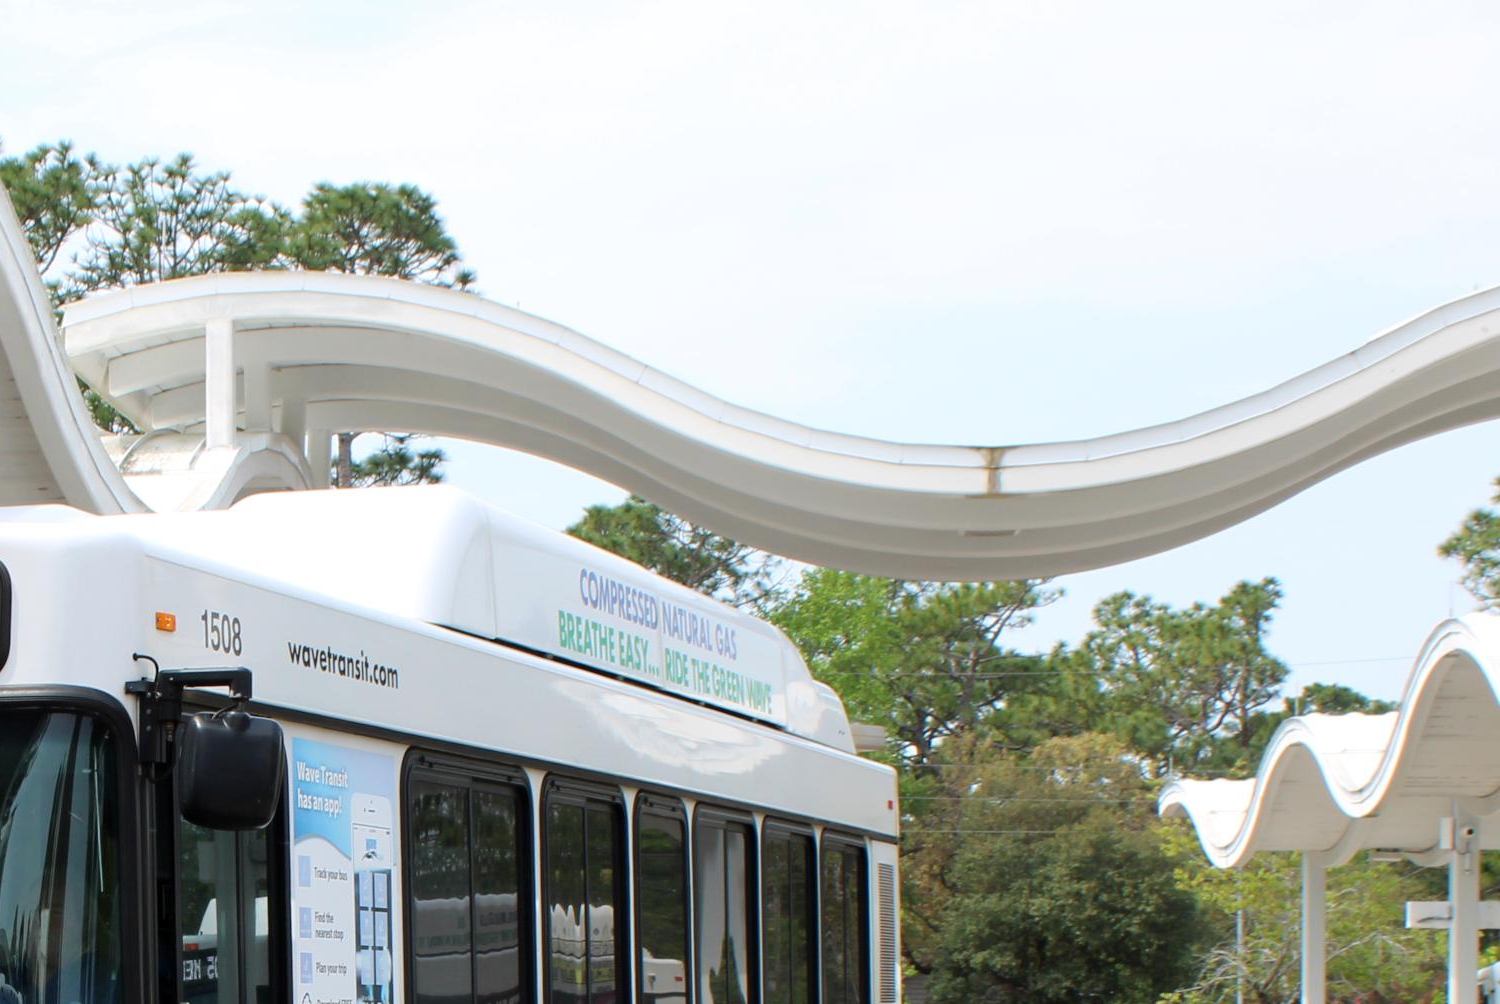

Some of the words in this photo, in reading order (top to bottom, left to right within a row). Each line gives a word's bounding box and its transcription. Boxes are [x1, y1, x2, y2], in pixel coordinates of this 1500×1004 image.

[580, 568, 658, 630] COMPRESSED
[662, 602, 712, 651] NATURAL
[716, 624, 737, 661] GAS
[201, 609, 242, 657] 1508
[288, 641, 399, 689] wavetransit.com
[558, 610, 615, 664] BREATHE
[618, 630, 660, 677] EASY...
[665, 648, 688, 687] RIDE
[691, 658, 709, 694] THE
[712, 664, 744, 704] GREEN
[746, 678, 772, 715] WAVE
[297, 761, 320, 782] Wave
[320, 765, 348, 788] Transit
[298, 788, 312, 810] has
[313, 795, 323, 811] an
[324, 796, 343, 818] app!
[314, 866, 328, 880] Track
[328, 869, 339, 882] your
[339, 868, 348, 881] bus
[315, 911, 325, 923] Find
[316, 961, 327, 974] Plan
[327, 963, 338, 976] your
[338, 962, 347, 976] trip
